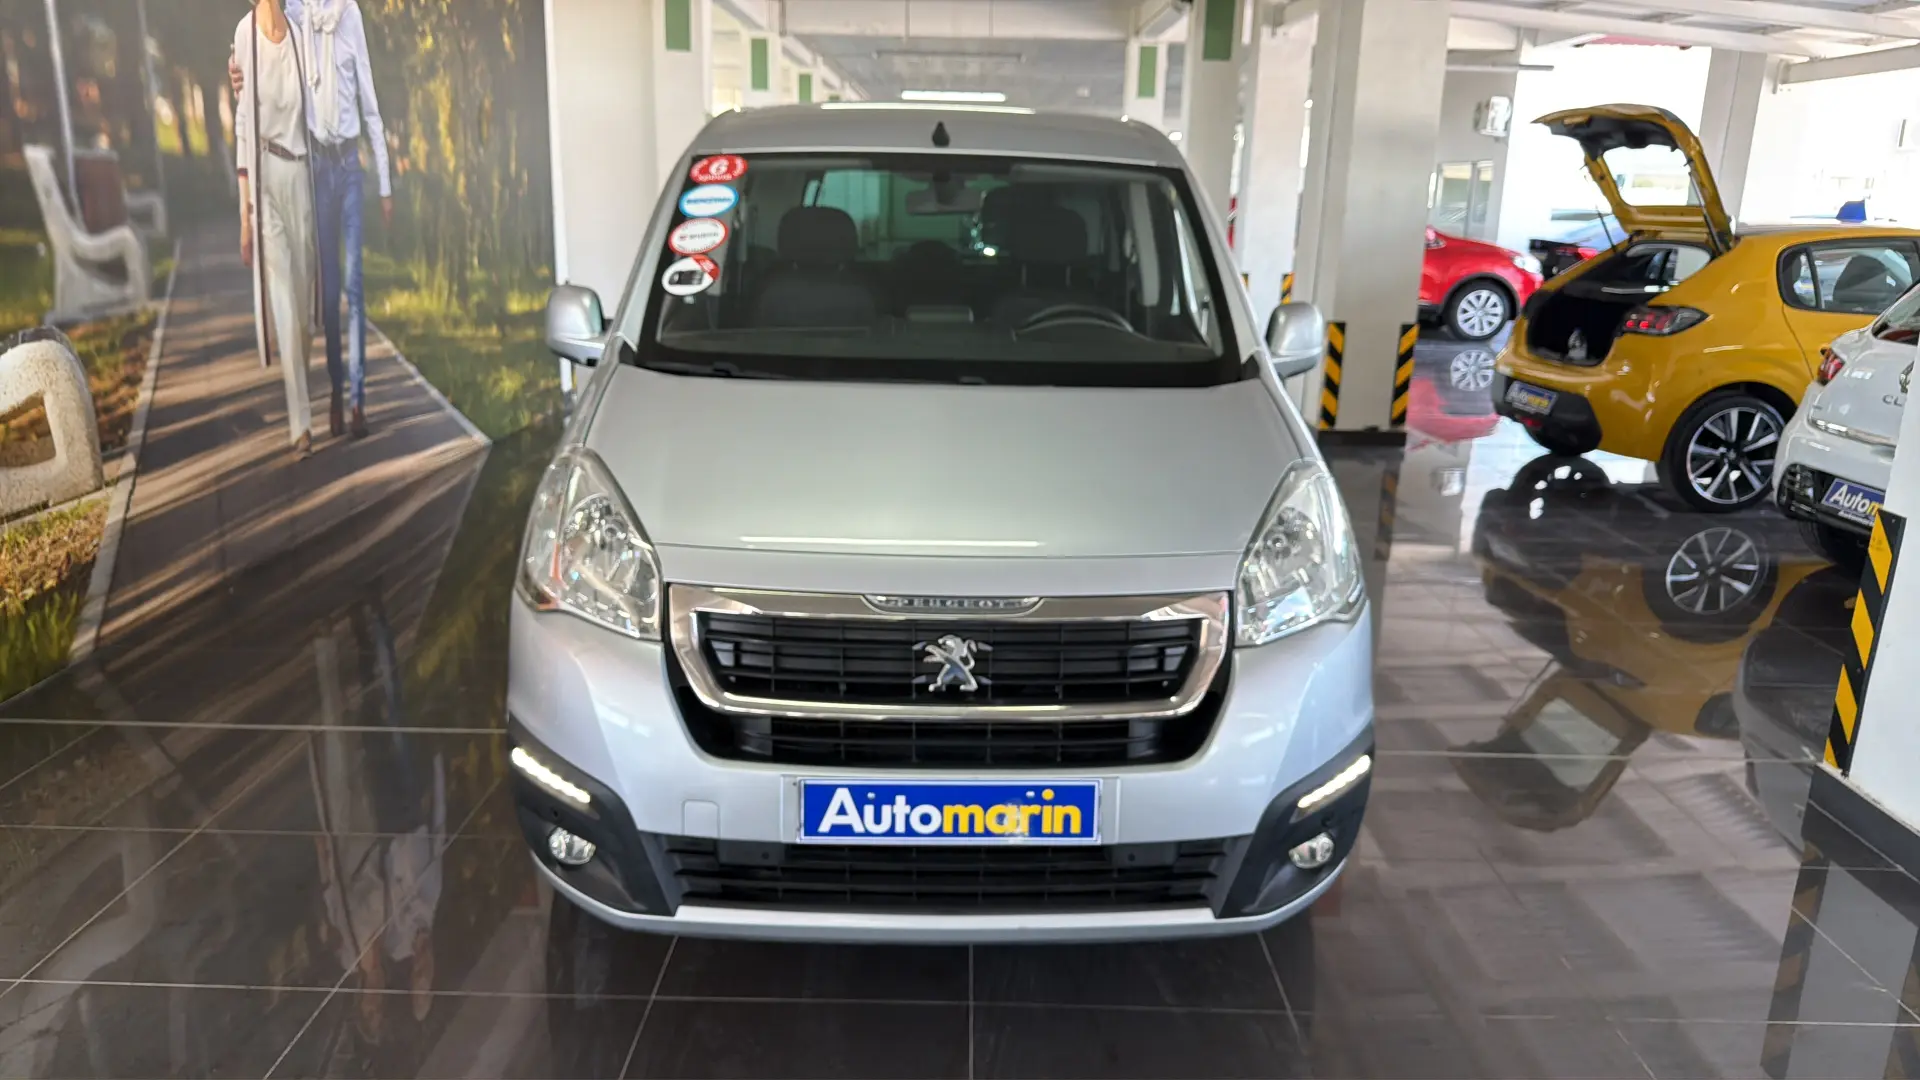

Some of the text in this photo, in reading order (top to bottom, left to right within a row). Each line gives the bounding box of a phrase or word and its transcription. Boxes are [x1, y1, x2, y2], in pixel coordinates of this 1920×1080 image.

[1882, 394, 1904, 407] CL
[1830, 484, 1883, 516] Autom
[817, 786, 1081, 834] Automarin
